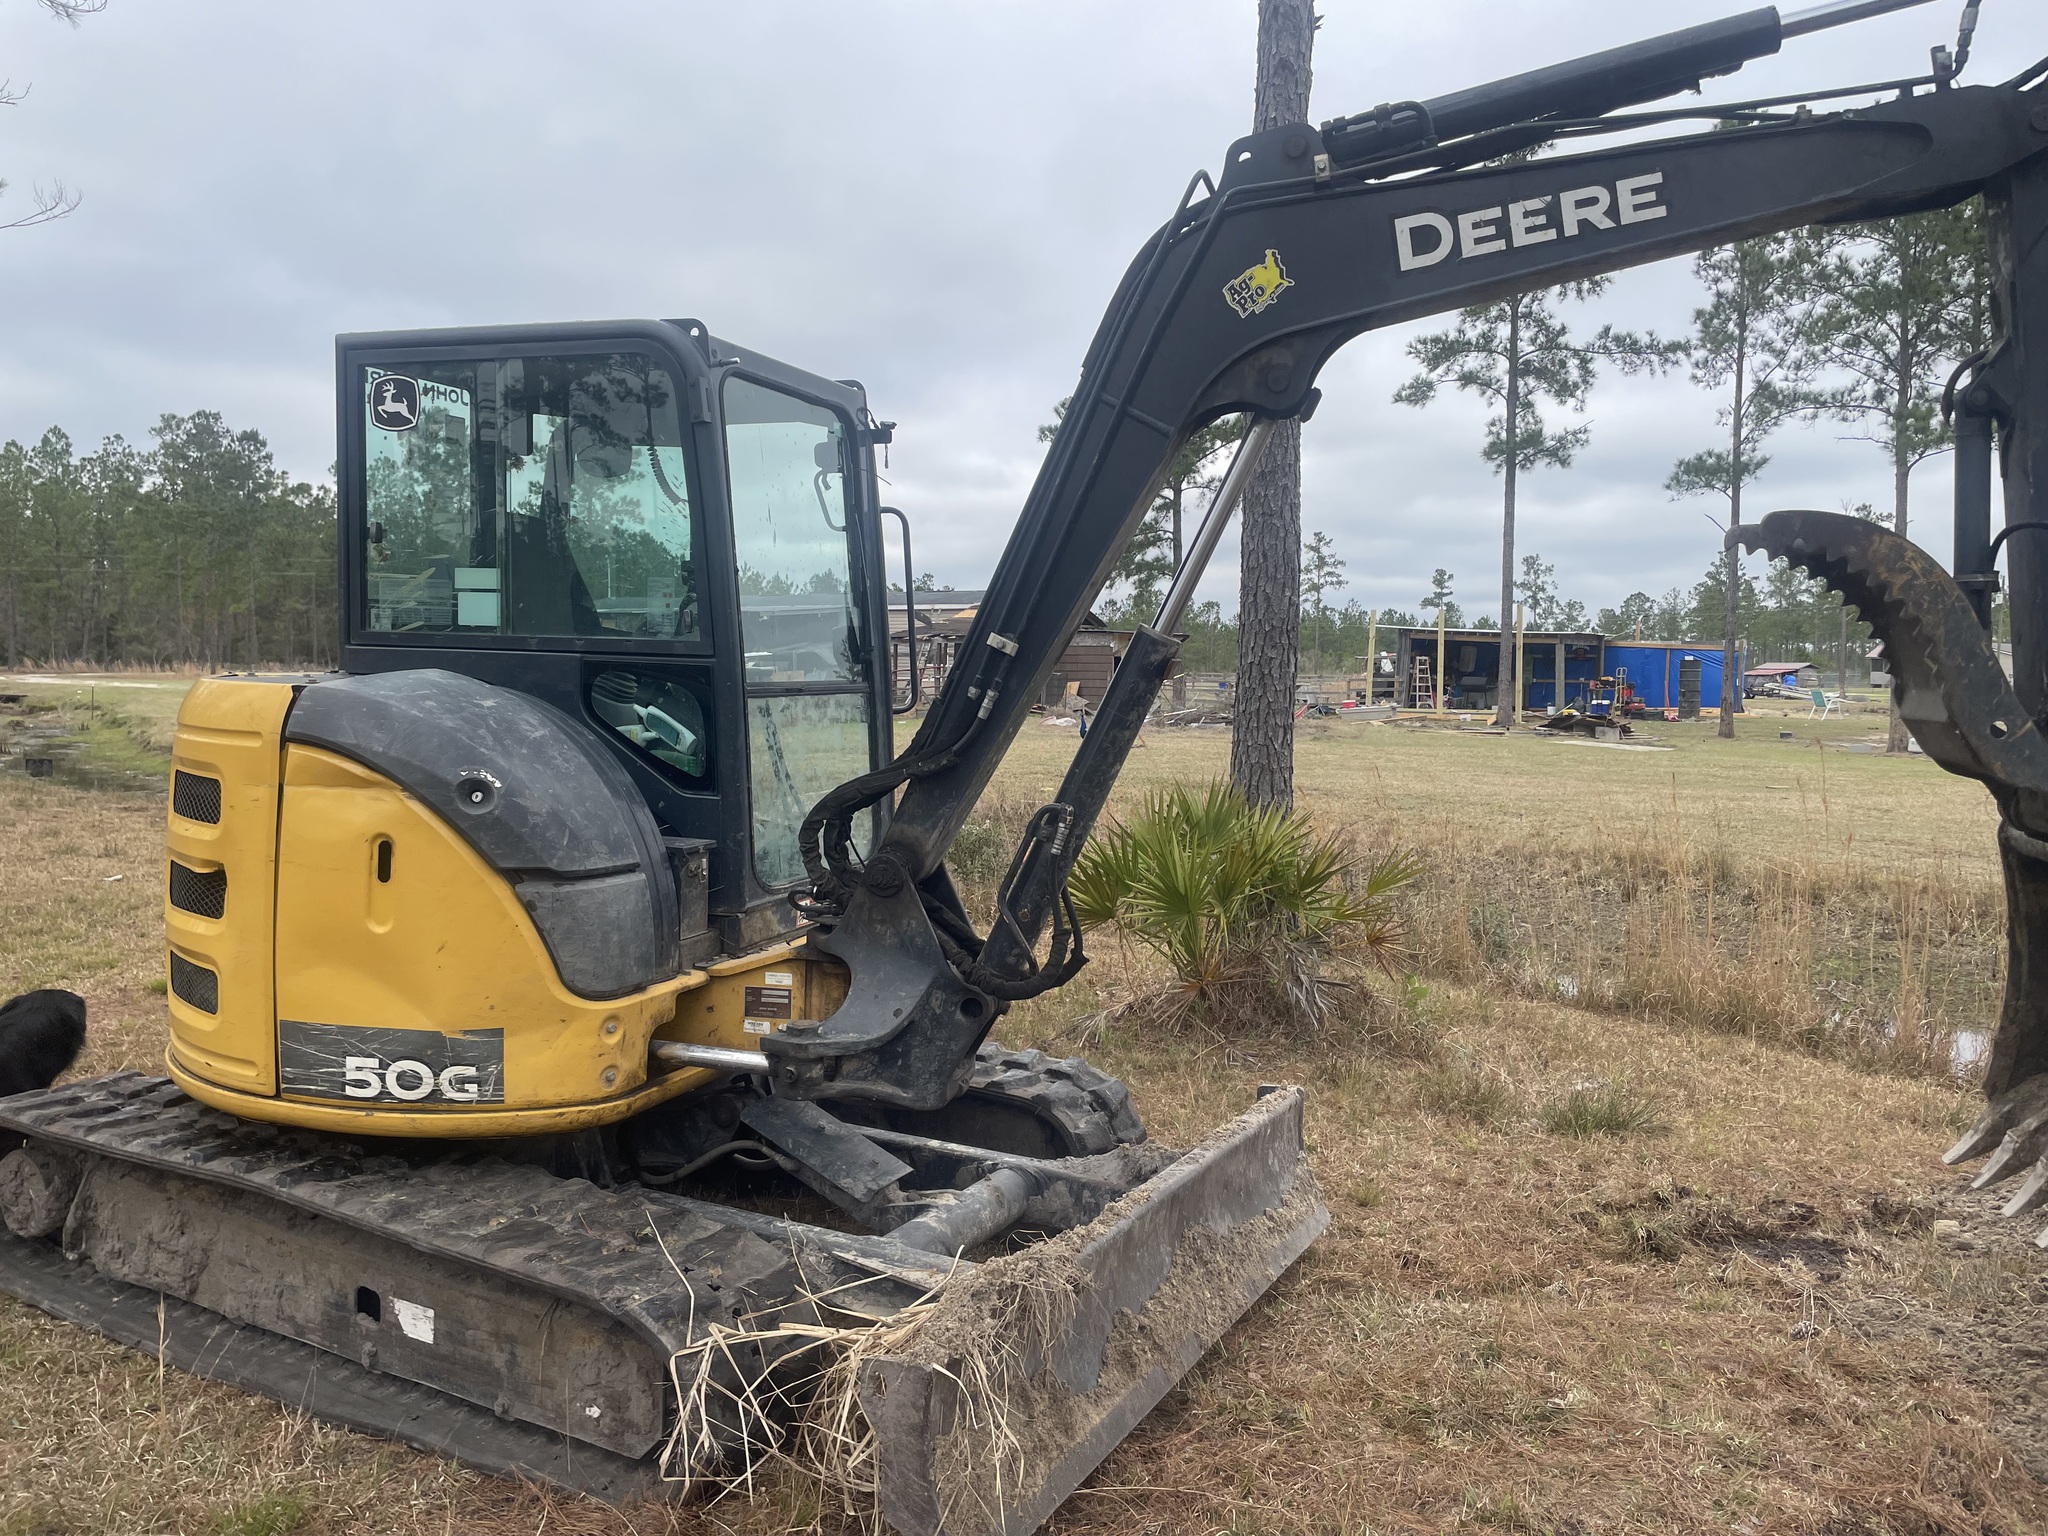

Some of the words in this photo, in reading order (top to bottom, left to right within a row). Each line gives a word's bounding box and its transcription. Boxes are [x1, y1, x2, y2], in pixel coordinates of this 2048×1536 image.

[1394, 171, 1668, 272] DEERE
[1235, 285, 1265, 314] Pro
[344, 1055, 479, 1102] 50G
